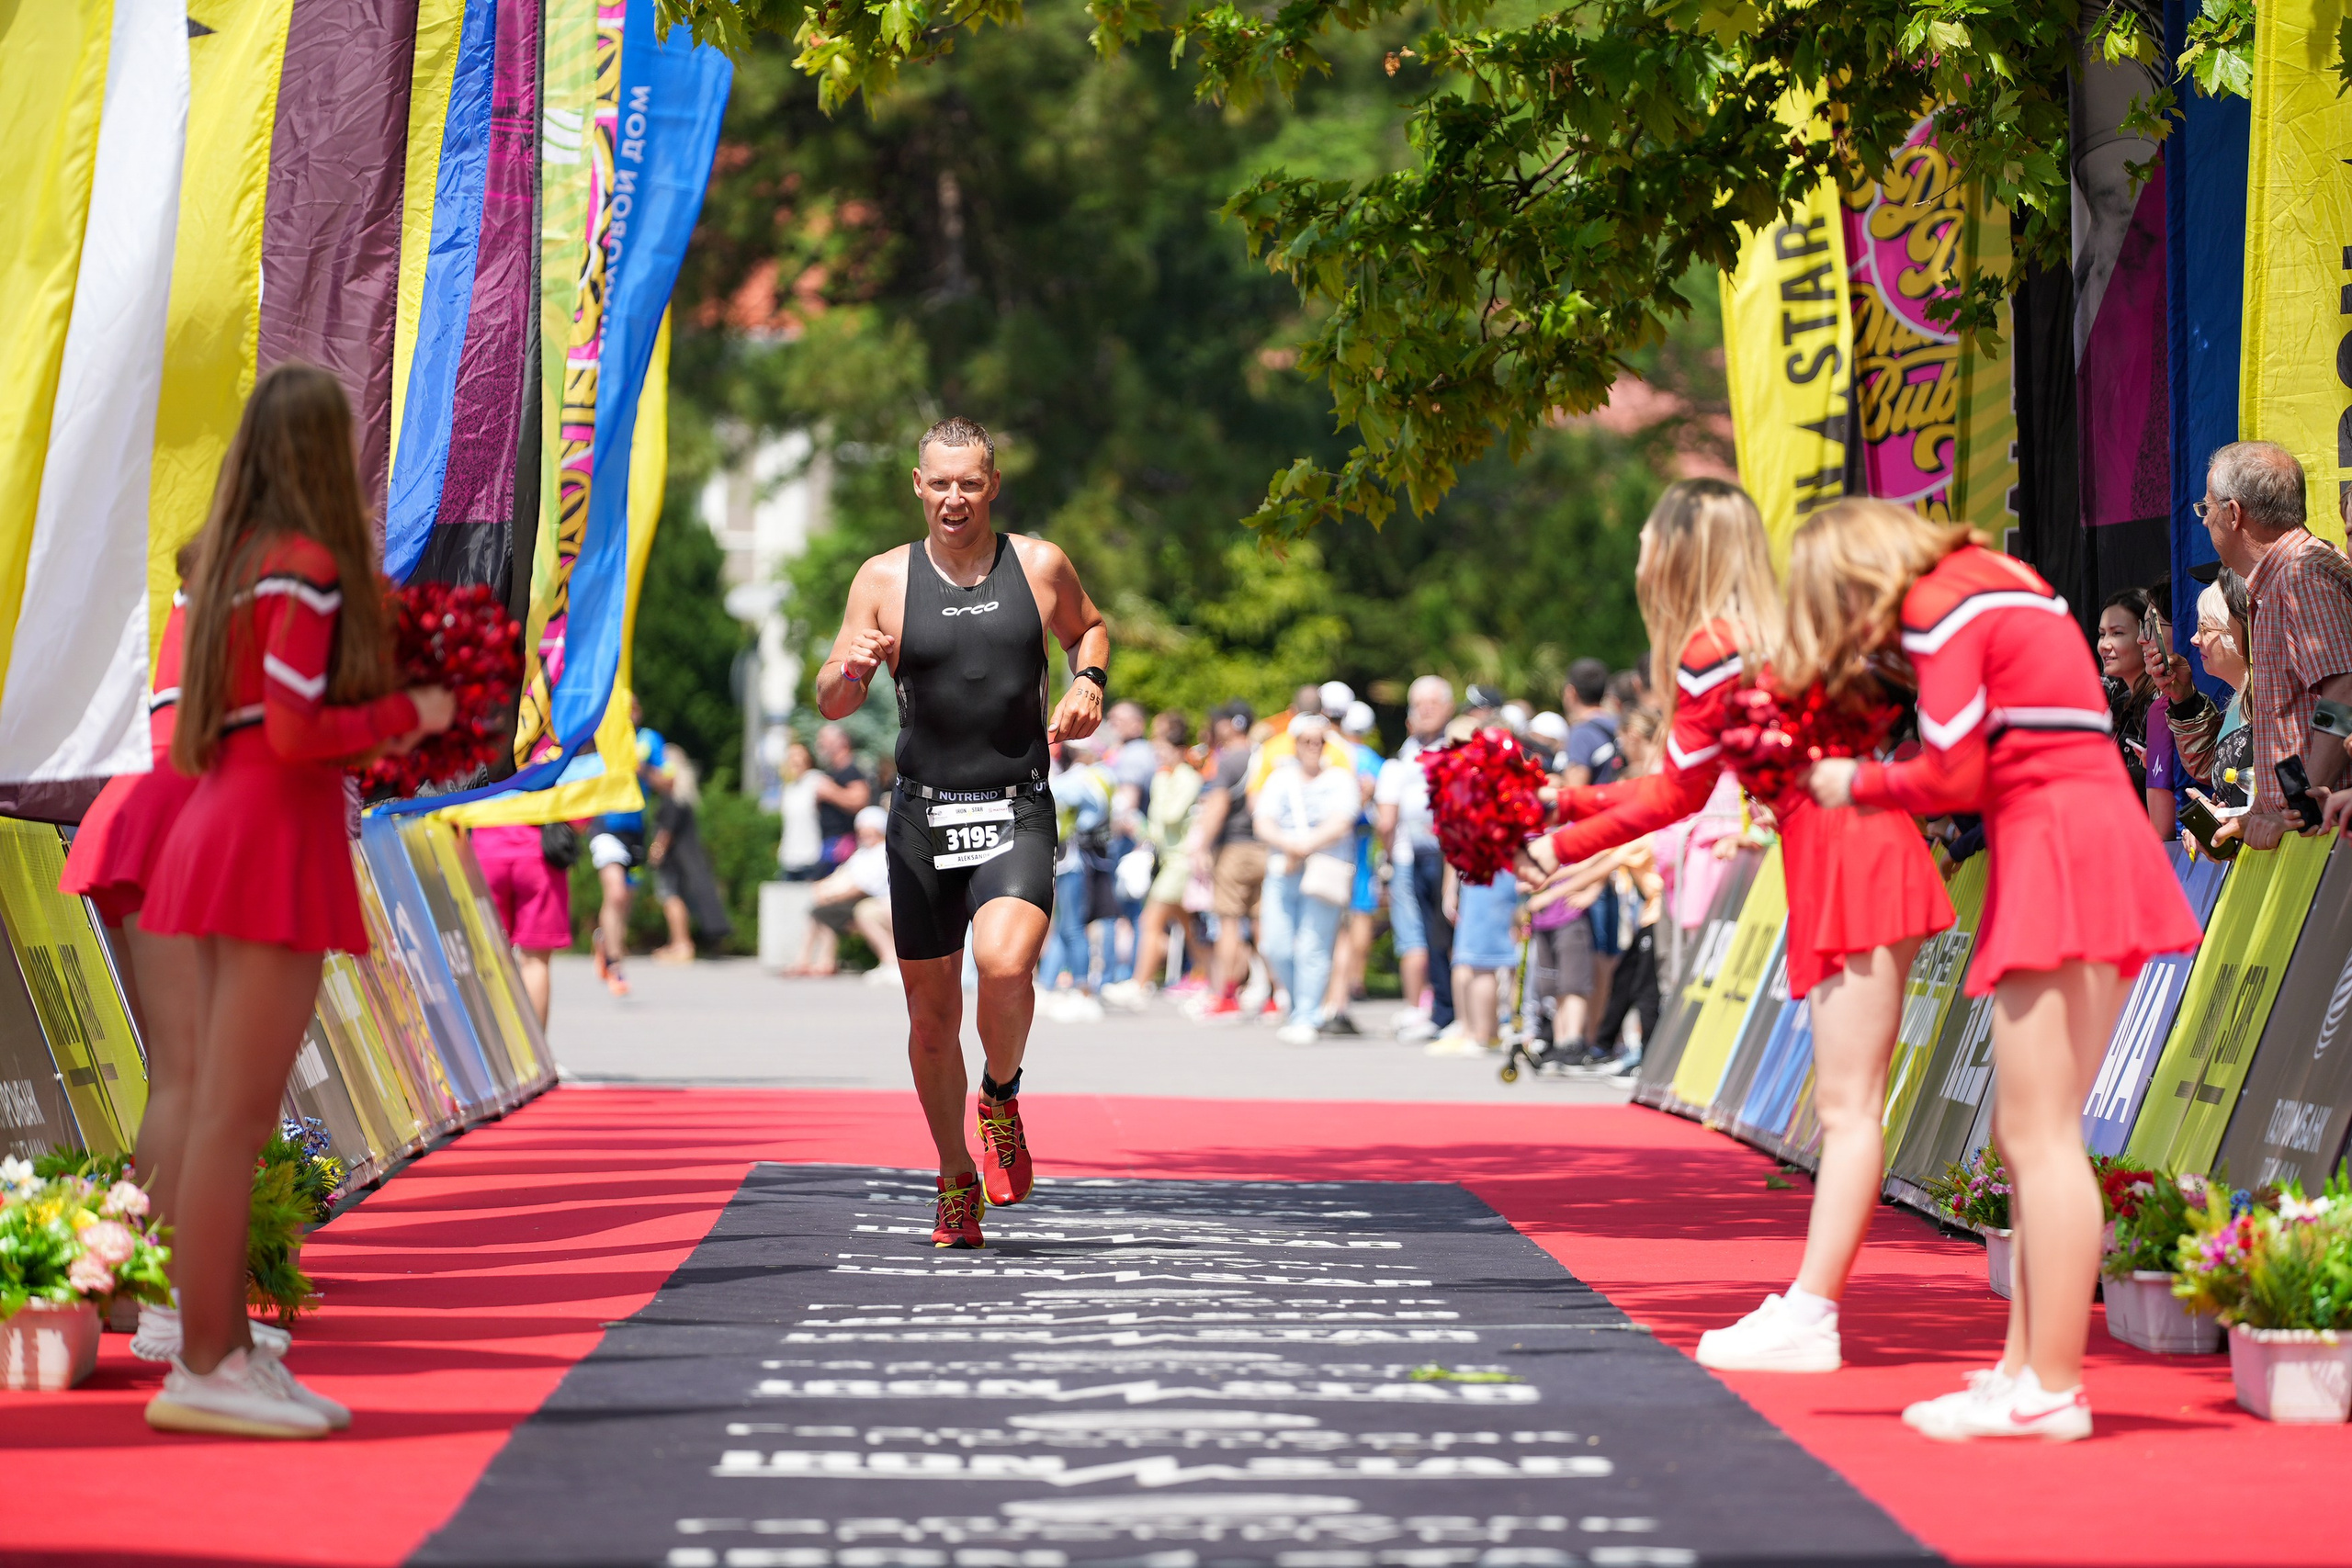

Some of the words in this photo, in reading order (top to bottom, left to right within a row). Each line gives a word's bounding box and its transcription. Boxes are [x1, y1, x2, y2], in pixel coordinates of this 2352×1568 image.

[621, 85, 651, 164] ДОМ
[1774, 216, 1842, 385] STAR
[942, 602, 999, 616] orca
[1076, 688, 1101, 705] 3195
[939, 791, 998, 801] NUTREND
[945, 825, 999, 851] 3195
[1190, 1272, 1433, 1286] STAR
